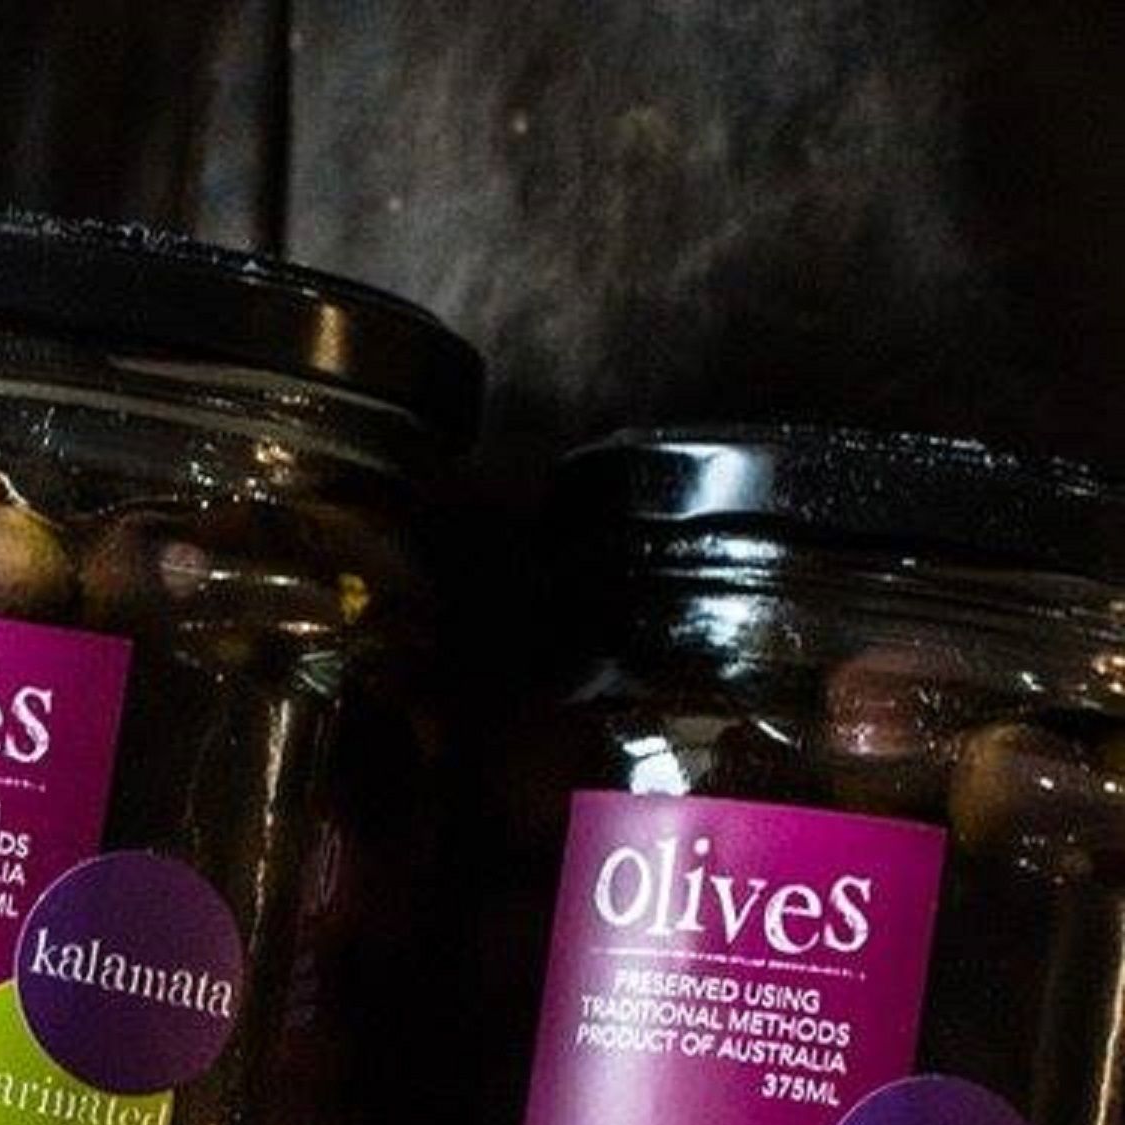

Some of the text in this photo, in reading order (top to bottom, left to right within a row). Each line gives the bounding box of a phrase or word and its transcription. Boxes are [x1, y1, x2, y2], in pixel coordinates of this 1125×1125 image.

[594, 838, 872, 954] olives
[29, 927, 235, 1019] kalamata
[612, 966, 821, 1015] PRESERVED USING
[581, 993, 852, 1048] TRADITIONAL METHODS
[575, 1022, 848, 1075] PRODUCT OF AUSTRALIA
[761, 1071, 842, 1107] 375ML
